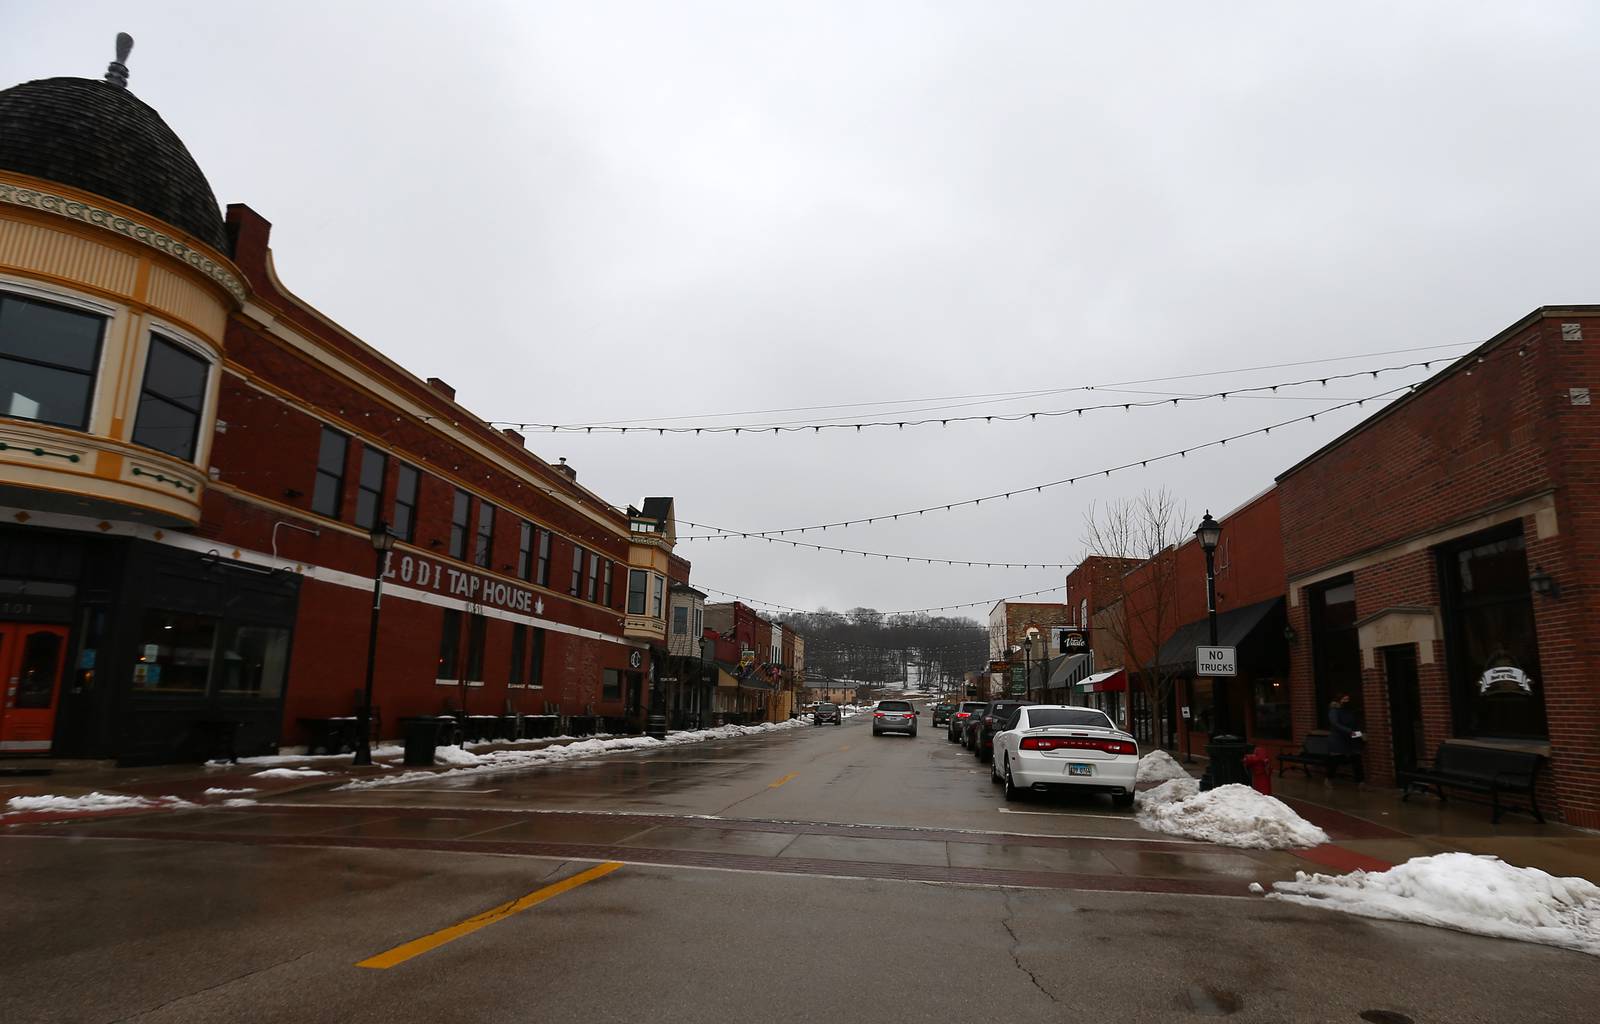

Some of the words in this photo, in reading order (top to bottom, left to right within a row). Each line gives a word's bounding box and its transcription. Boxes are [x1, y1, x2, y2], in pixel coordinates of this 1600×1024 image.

[383, 551, 442, 590] LODI
[448, 569, 480, 598] TAP
[483, 579, 533, 612] HOUSE
[1209, 650, 1224, 661] NO
[1200, 663, 1234, 672] TRUCKS
